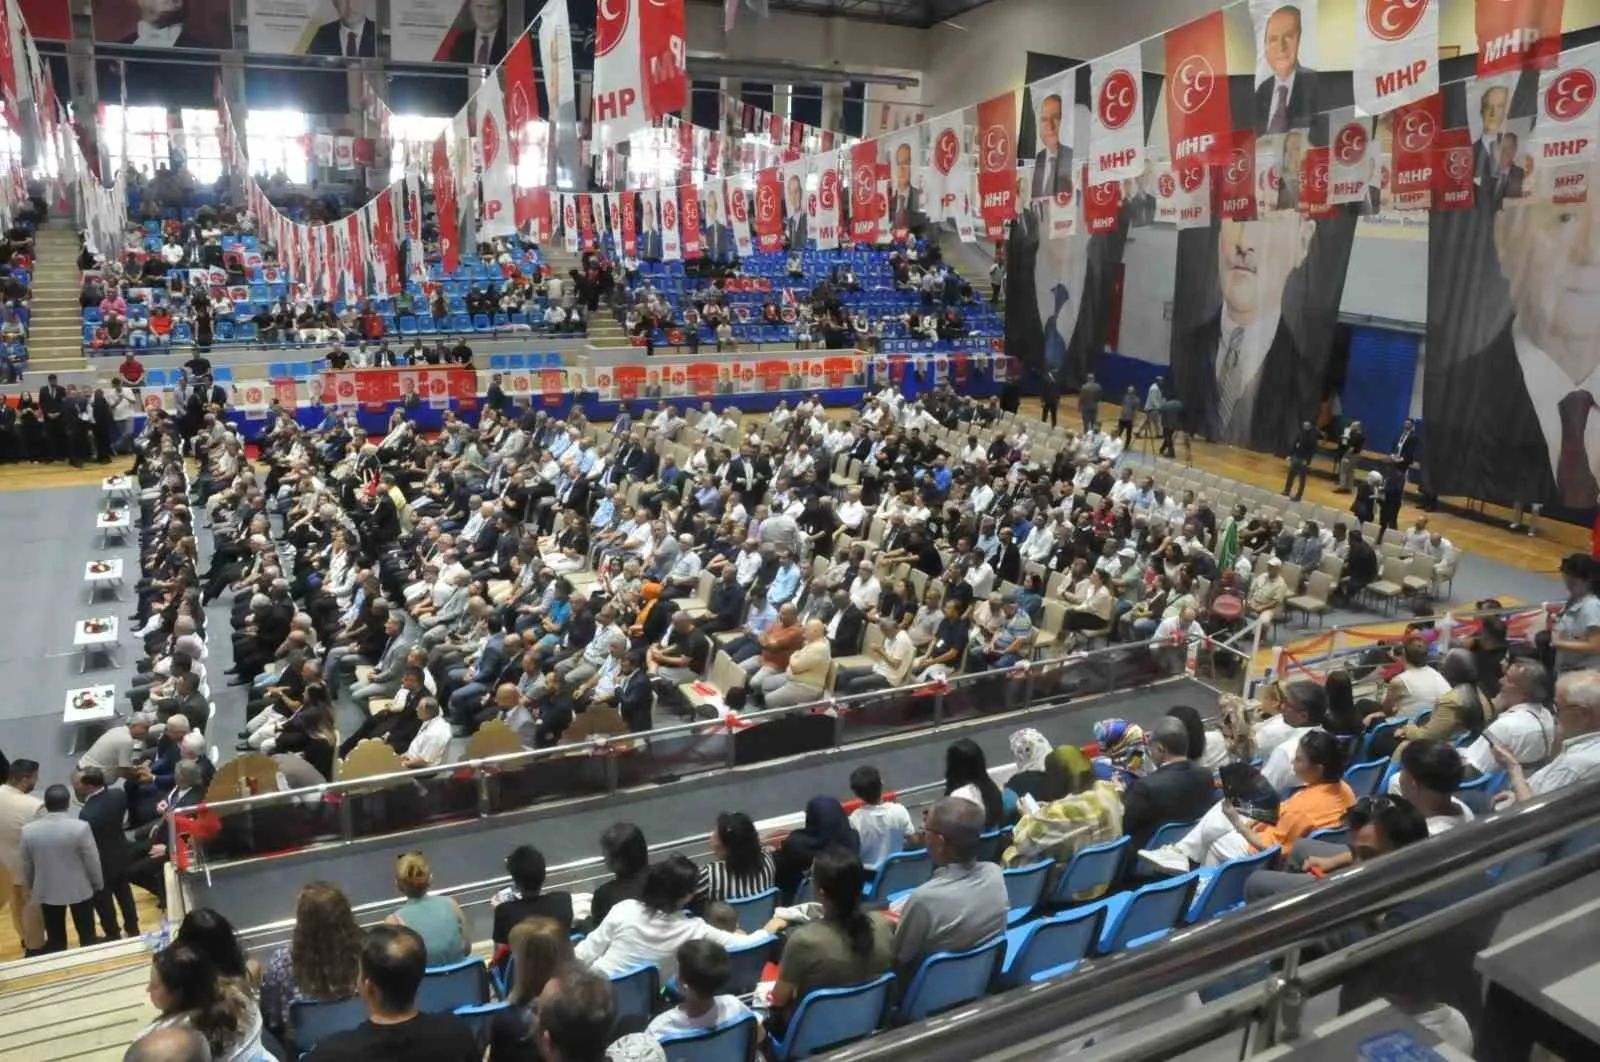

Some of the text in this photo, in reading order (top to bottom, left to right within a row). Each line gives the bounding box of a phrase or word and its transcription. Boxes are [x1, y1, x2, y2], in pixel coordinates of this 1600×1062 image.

[1484, 28, 1540, 65] MHP
[1375, 59, 1427, 97] MHP
[1176, 134, 1215, 161] MHP
[1543, 138, 1588, 157] MHP
[1100, 148, 1136, 171] MHP
[1397, 167, 1432, 185] MHP
[1554, 174, 1584, 188] MHP
[1334, 181, 1364, 195] MHP
[984, 191, 1010, 208] MHP
[1444, 190, 1469, 202] MHP
[1223, 198, 1248, 211] MHP
[1180, 207, 1202, 219] MHP
[855, 221, 874, 234] MHP
[1092, 217, 1114, 228] MHP
